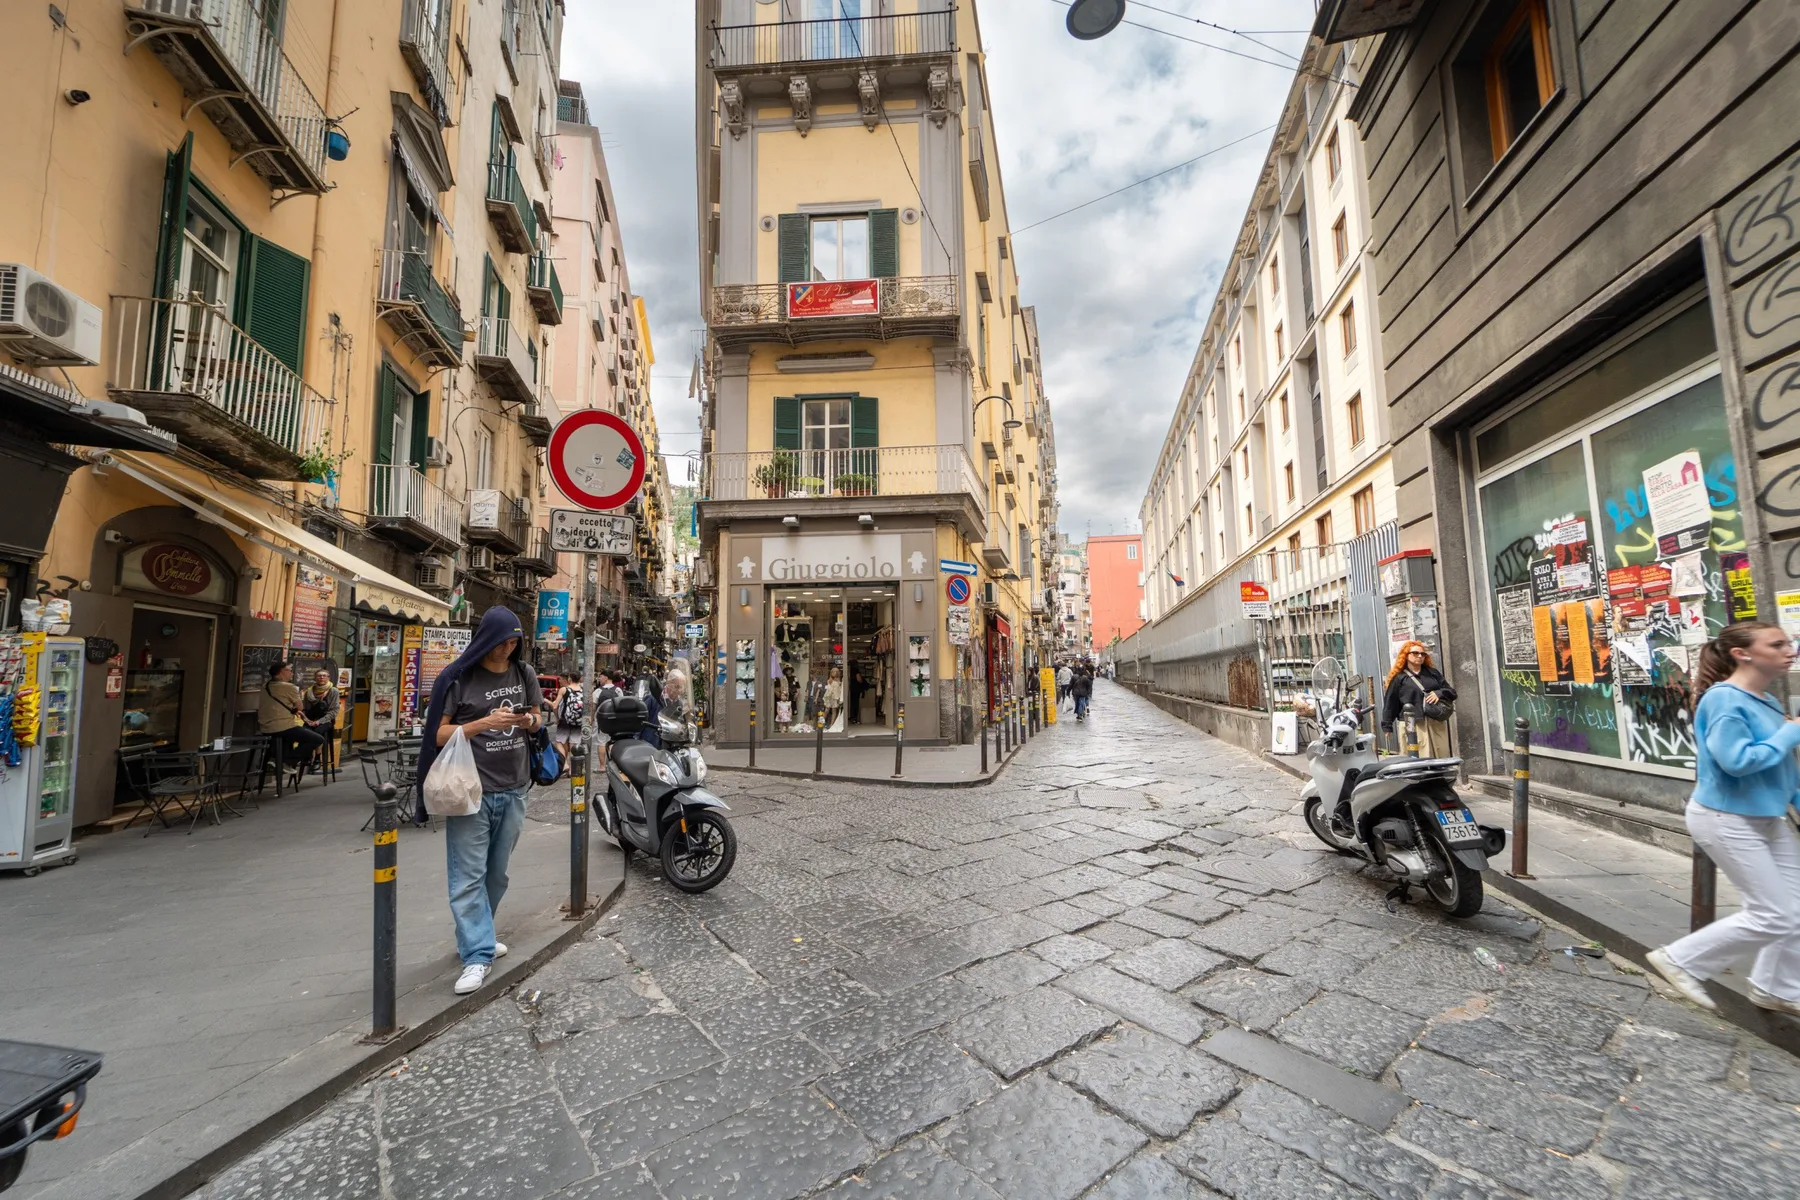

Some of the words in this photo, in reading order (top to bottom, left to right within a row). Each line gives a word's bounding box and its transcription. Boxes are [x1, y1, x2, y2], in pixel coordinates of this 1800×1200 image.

[1648, 472, 1663, 482] STOP
[1650, 480, 1672, 494] DIRITTO
[579, 518, 612, 528] eccetto
[769, 556, 895, 581] Giuggiolo
[1533, 564, 1551, 575] SOLO
[391, 595, 425, 612] Caffetteria
[424, 629, 446, 639] STAMPA
[447, 631, 471, 641] DIGITALE
[243, 647, 281, 666] SPRITZ
[404, 648, 417, 689] STAMPA
[484, 684, 523, 701] SCIENCE
[1445, 811, 1460, 824] EX
[1444, 824, 1479, 839] 73613
